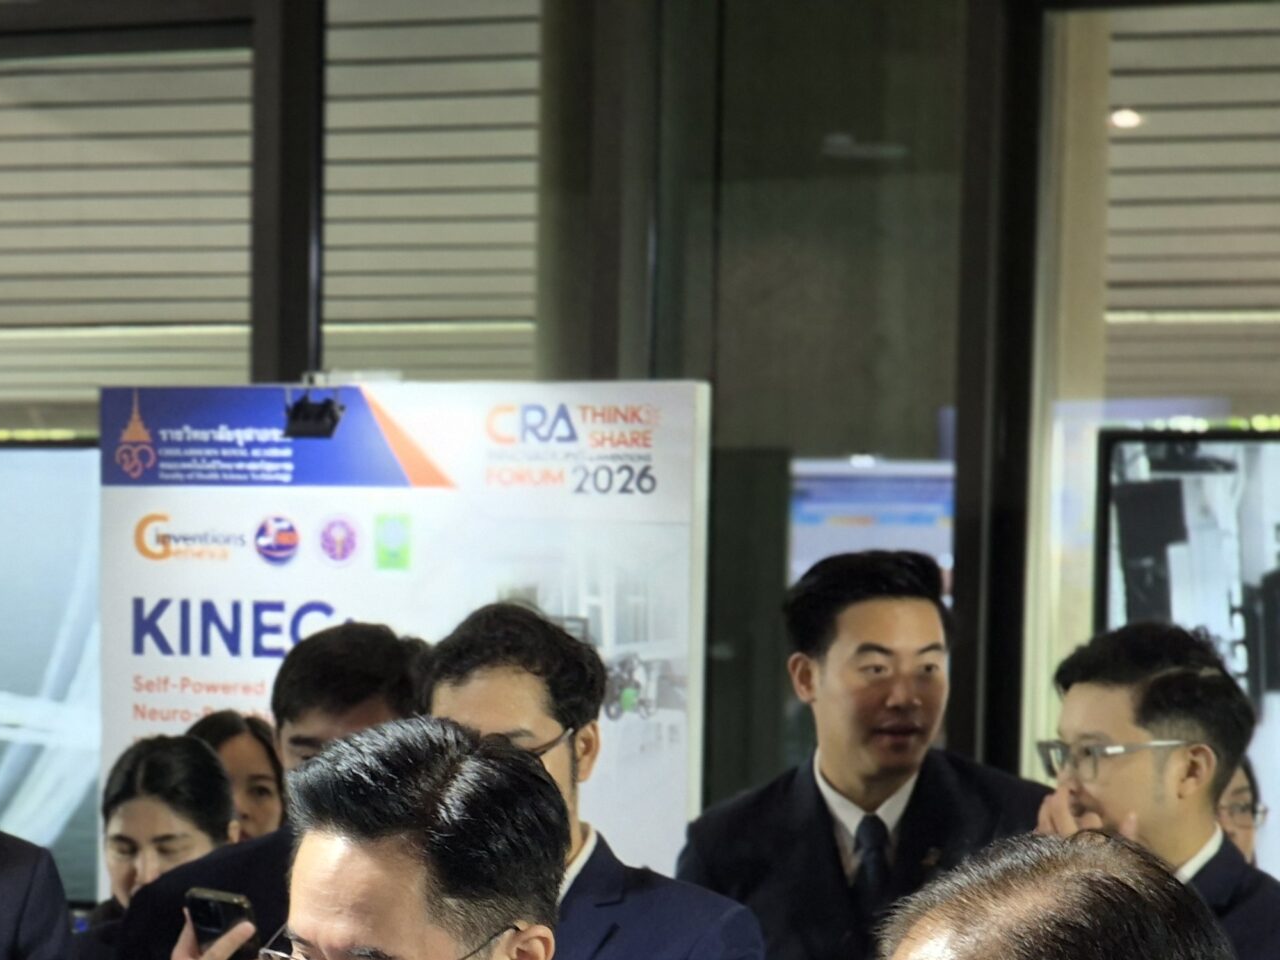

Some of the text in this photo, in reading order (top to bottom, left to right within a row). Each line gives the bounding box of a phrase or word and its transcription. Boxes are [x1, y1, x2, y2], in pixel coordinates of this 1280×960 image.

[486, 402, 579, 445] CRA
[589, 430, 653, 448] SHARE
[571, 464, 657, 494] 2026
[132, 597, 355, 658] KINEC
[133, 675, 266, 696] Self-Powered
